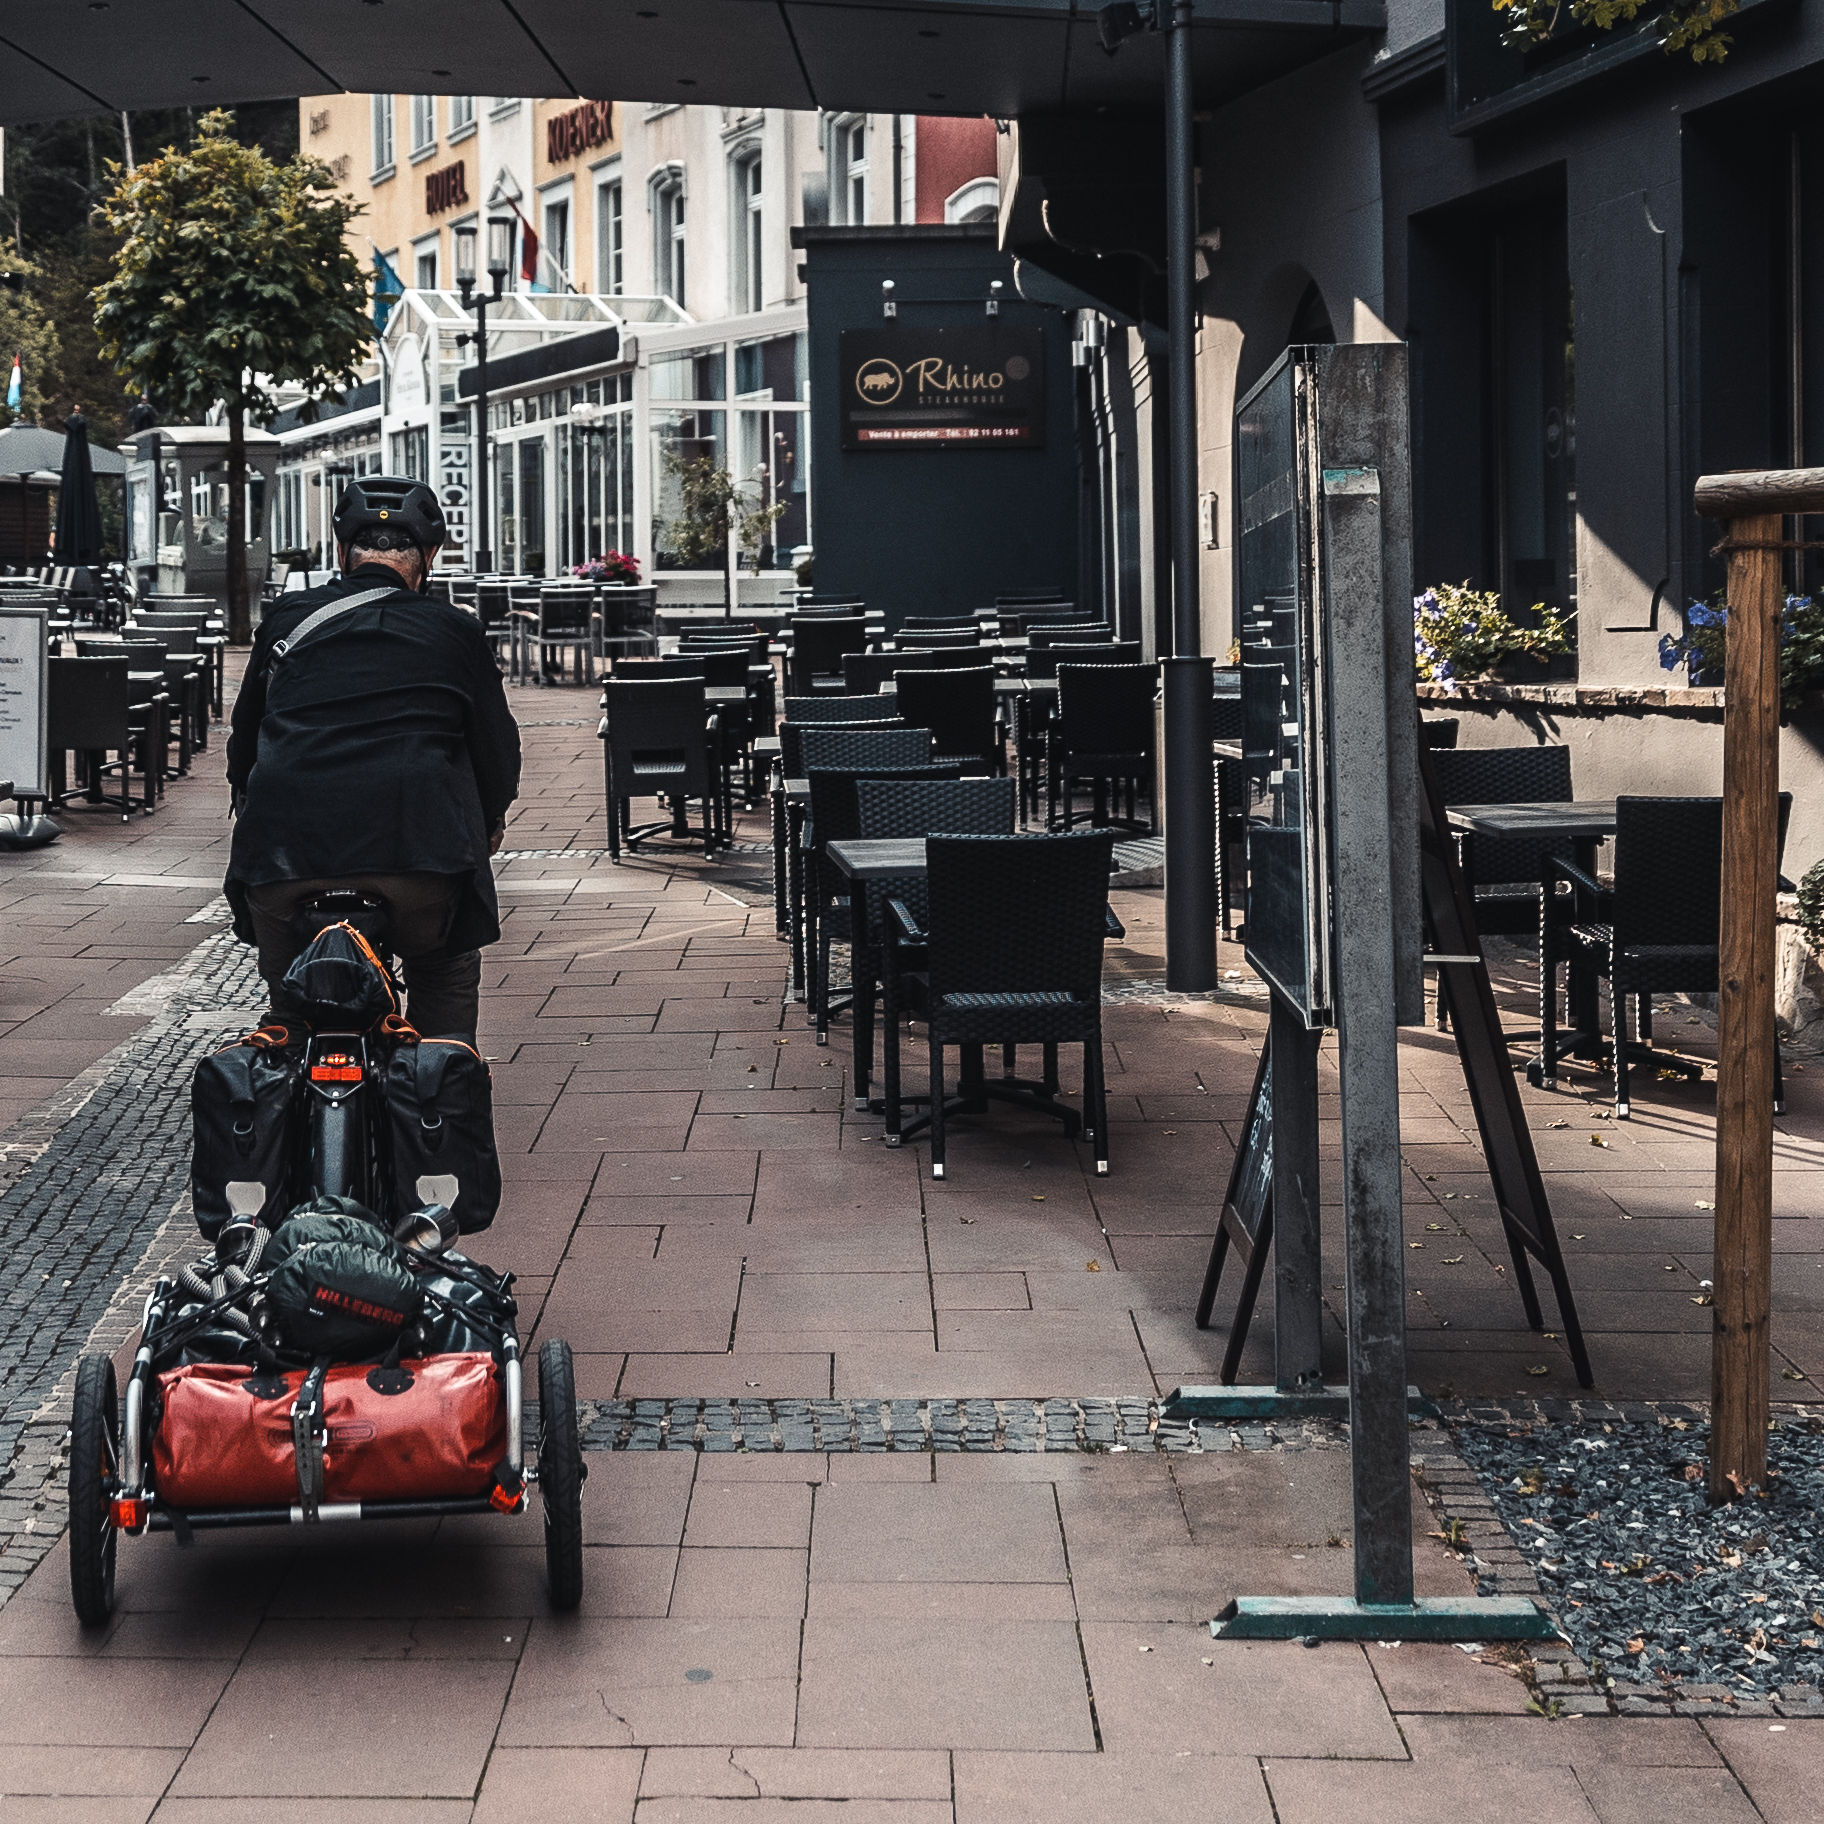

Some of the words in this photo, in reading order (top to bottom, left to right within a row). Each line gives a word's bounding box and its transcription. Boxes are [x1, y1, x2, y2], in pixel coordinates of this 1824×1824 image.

[547, 100, 614, 164] KOENER
[426, 159, 468, 215] HOTEL
[905, 357, 1004, 393] Rhino
[918, 395, 1004, 405] STEAKHOUSE
[316, 1286, 404, 1326] HILLEBERG
